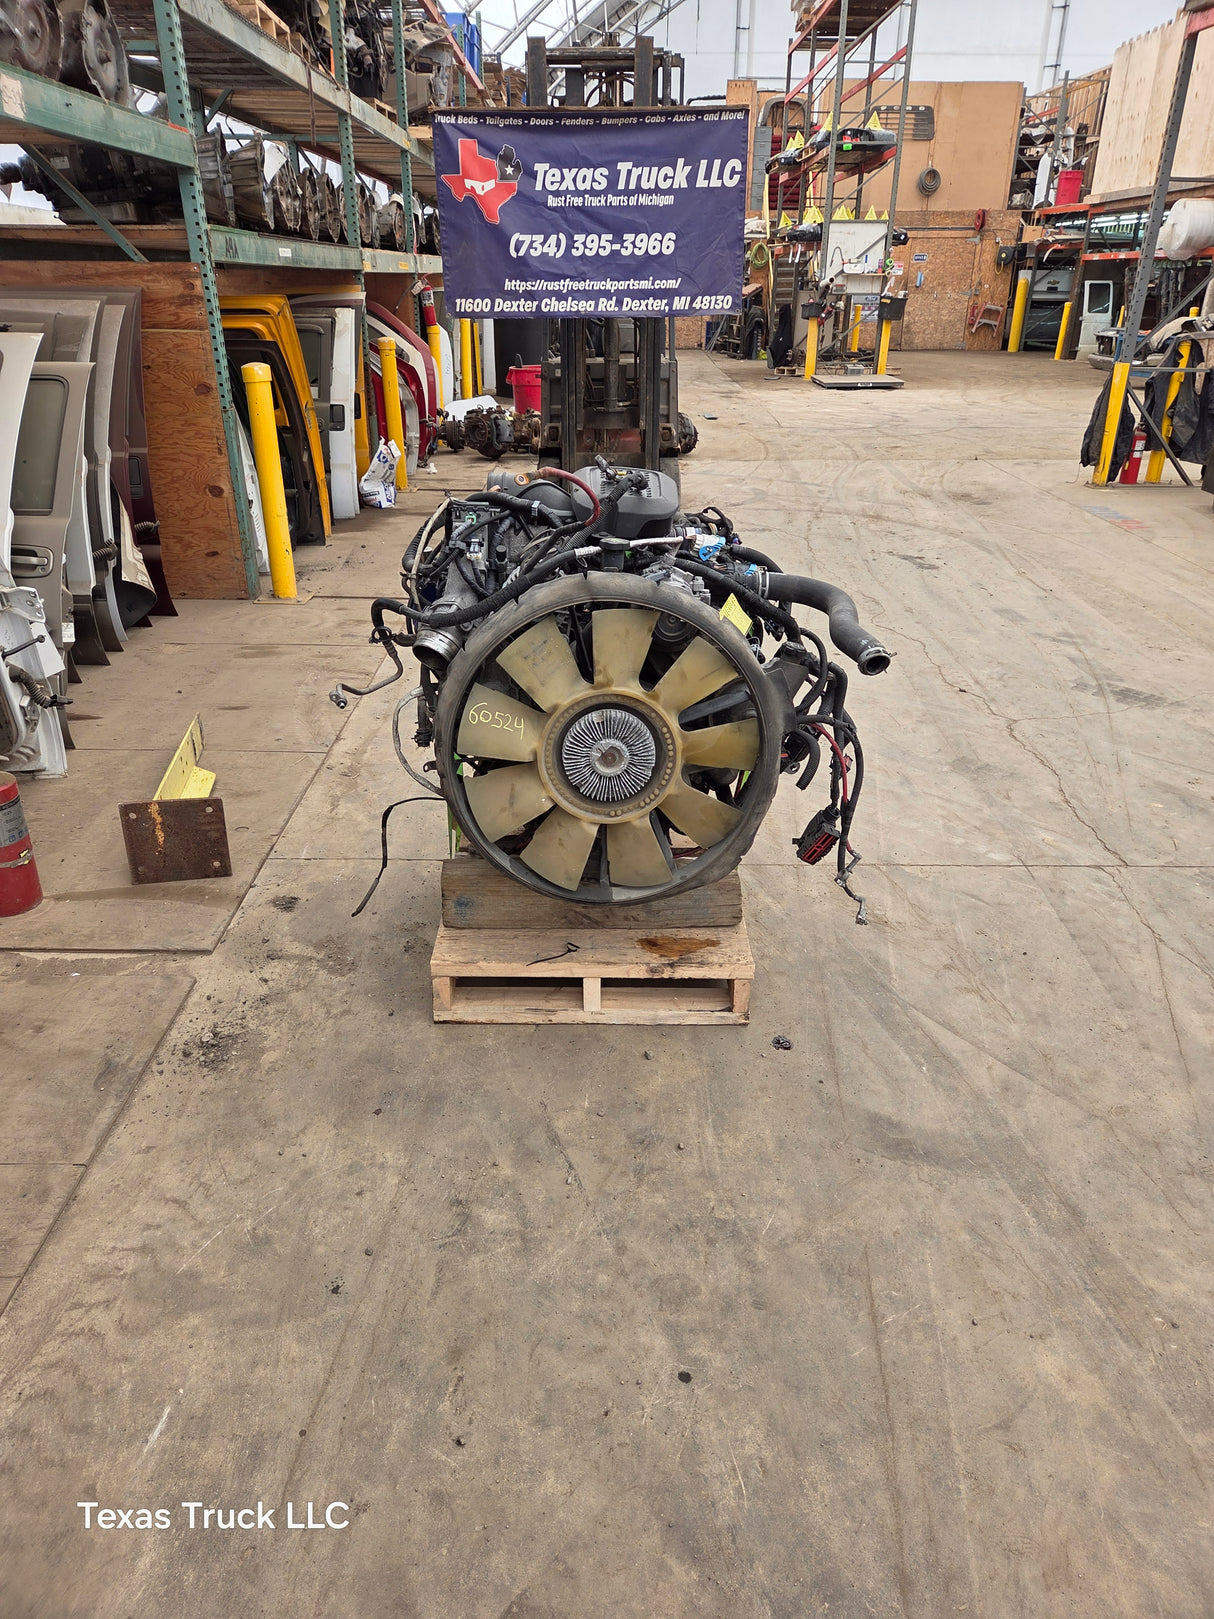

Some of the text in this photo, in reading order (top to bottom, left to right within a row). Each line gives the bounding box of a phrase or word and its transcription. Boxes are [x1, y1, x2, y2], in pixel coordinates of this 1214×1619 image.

[434, 113, 456, 124] Truck
[457, 115, 478, 125] Beds
[485, 116, 523, 127] Tailgates
[530, 117, 554, 126] Doors
[561, 117, 594, 126] Fenders
[601, 117, 638, 126] Bumpers
[645, 115, 666, 123] Cabs
[673, 113, 697, 122] Axles
[703, 112, 719, 121] and
[721, 110, 745, 120] More!
[533, 158, 742, 191] Texas Truck LLC
[547, 194, 674, 207] Rust Free Truck Parts of Michigan
[509, 232, 677, 259] (734) 395-3966
[504, 276, 682, 293] https://rustfreetruckpartsmi.com/
[455, 295, 733, 313] 11600 Dexter Chelsea Rd. Dexter, MI 48130
[469, 702, 524, 741] 60524
